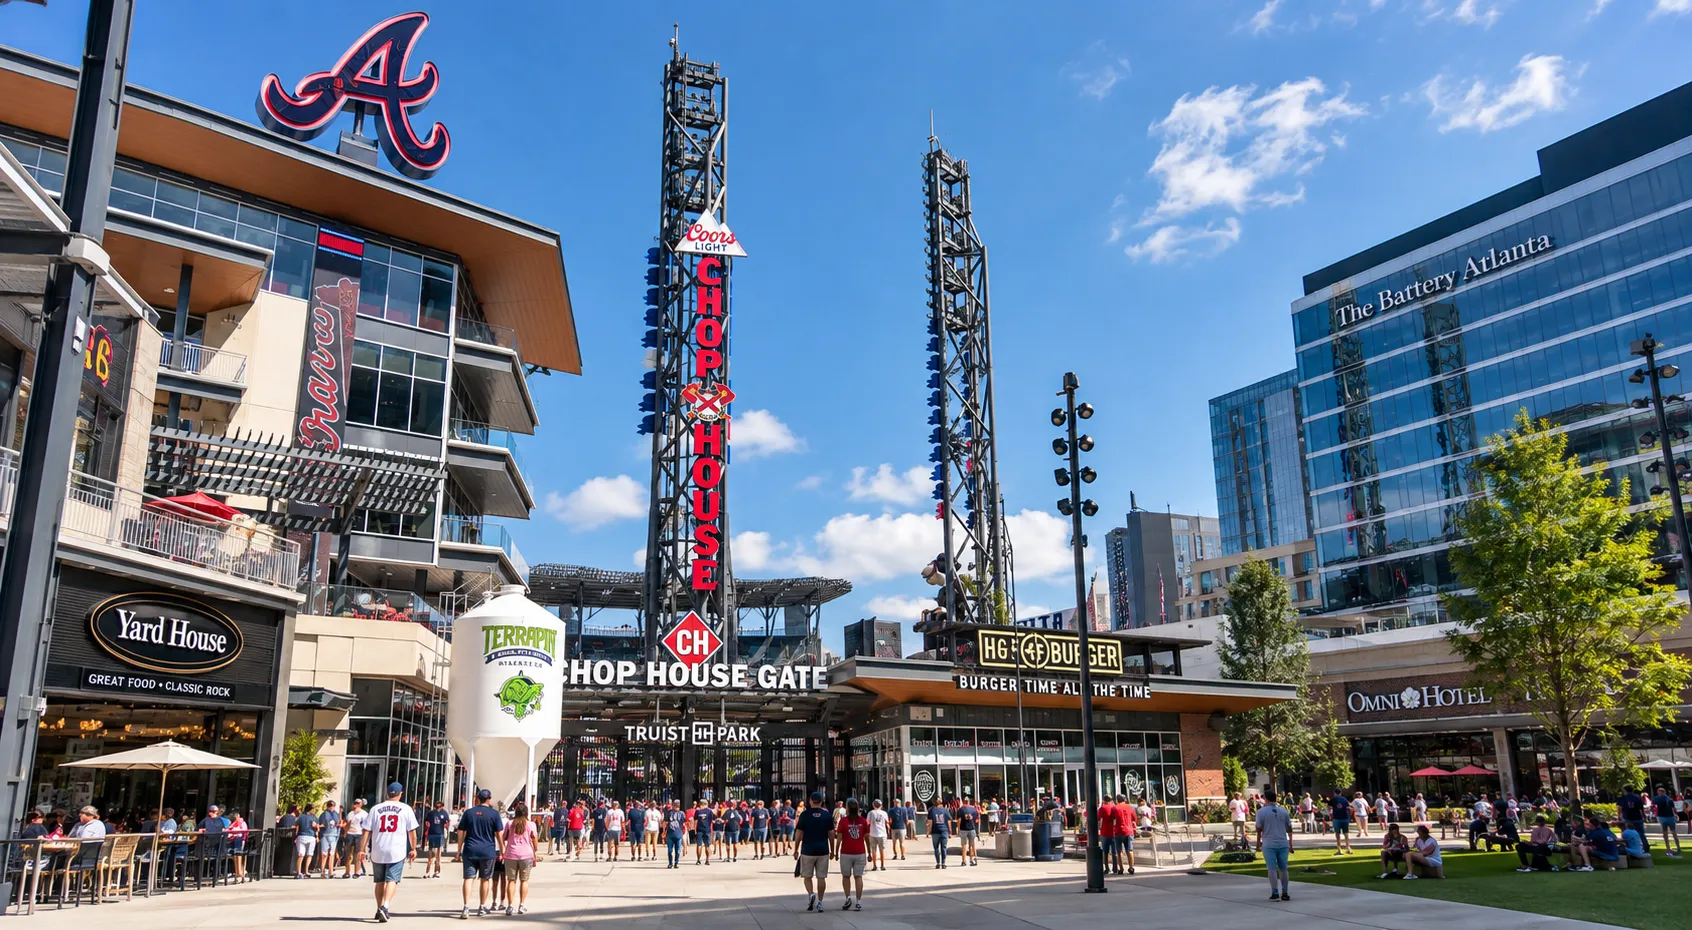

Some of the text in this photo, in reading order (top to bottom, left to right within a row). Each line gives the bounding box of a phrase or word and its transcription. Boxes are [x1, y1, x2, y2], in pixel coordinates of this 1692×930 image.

[686, 224, 736, 245] Coors
[695, 242, 728, 252] LIGHT
[1336, 234, 1552, 328] The Battery Atlanta
[695, 257, 723, 377] CHOP
[692, 423, 721, 591] HOUSE
[116, 608, 227, 653] Yard House
[482, 625, 557, 659] TERRAPIN
[676, 629, 709, 656] CH
[88, 674, 231, 697] GREAT FOOD CLASSIC ROCK
[646, 661, 748, 688] HOUSE
[757, 664, 829, 690] GATE
[960, 675, 1017, 691] BURGER
[1024, 680, 1058, 694] TIME
[1093, 683, 1116, 697] THE
[1121, 685, 1151, 699] TIME
[1347, 685, 1493, 713] OMNI HOTEL
[624, 725, 761, 742] TRUIST PARK
[379, 814, 398, 833] 13
